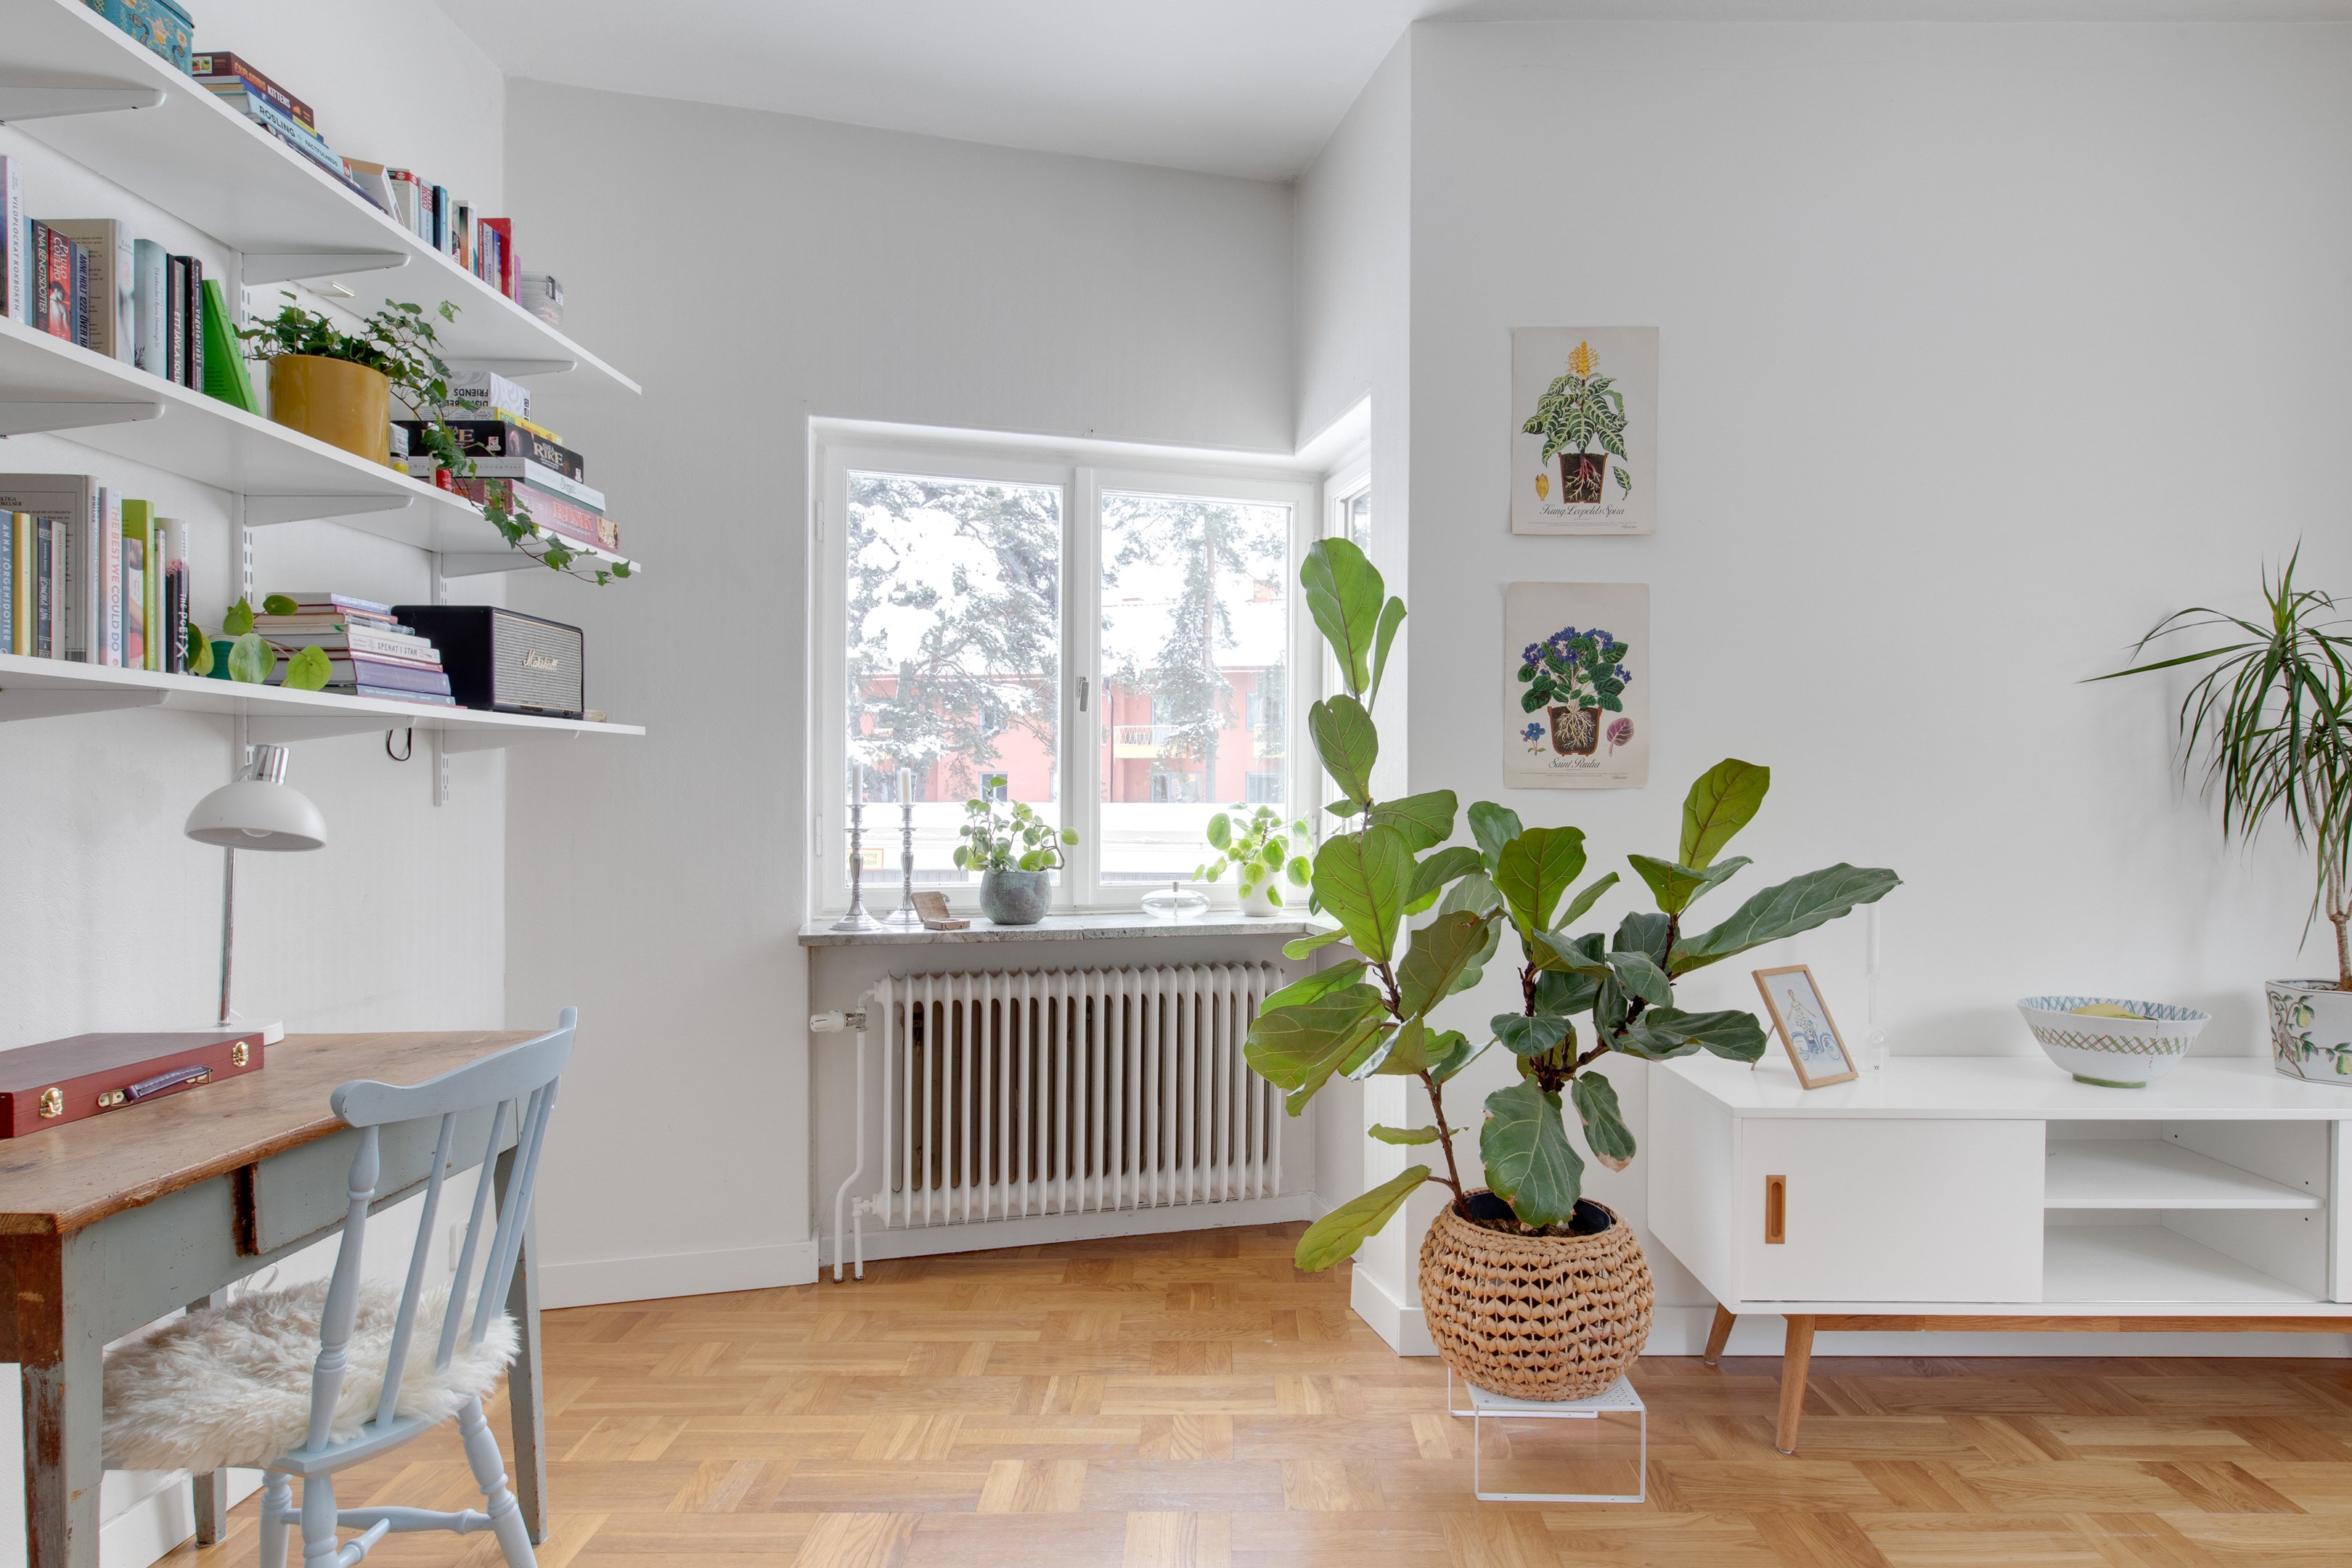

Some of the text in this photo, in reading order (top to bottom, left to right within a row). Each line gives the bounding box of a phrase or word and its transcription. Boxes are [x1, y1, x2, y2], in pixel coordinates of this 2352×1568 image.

[234, 62, 291, 109] EXPLODING KITTENS
[259, 105, 296, 138] ROSLING
[304, 139, 338, 167] FACTFULNESS
[38, 226, 47, 248] LINA
[59, 244, 69, 279] PAULO
[79, 253, 88, 276] ANNE
[38, 249, 47, 314] BENGTSDOTTER
[79, 276, 88, 295] HOLT
[79, 295, 88, 314] 1222
[79, 314, 89, 336] ÖVER
[173, 330, 182, 357] JÄVLA
[454, 388, 489, 397] FRIENDS
[533, 441, 564, 467] RIKE
[111, 505, 120, 529] THE
[552, 502, 593, 532] RISK
[1540, 505, 1625, 518] Kung Leopolds Spira
[111, 531, 120, 560] BEST
[111, 564, 120, 583] WE
[111, 585, 120, 629] COULD
[178, 611, 189, 641] POET
[111, 632, 120, 652] DO
[175, 642, 189, 658] X
[377, 642, 399, 653] SPENAT
[404, 647, 417, 656] STAN
[523, 650, 558, 671] Marshall
[1548, 757, 1601, 769] Saint Paulia
